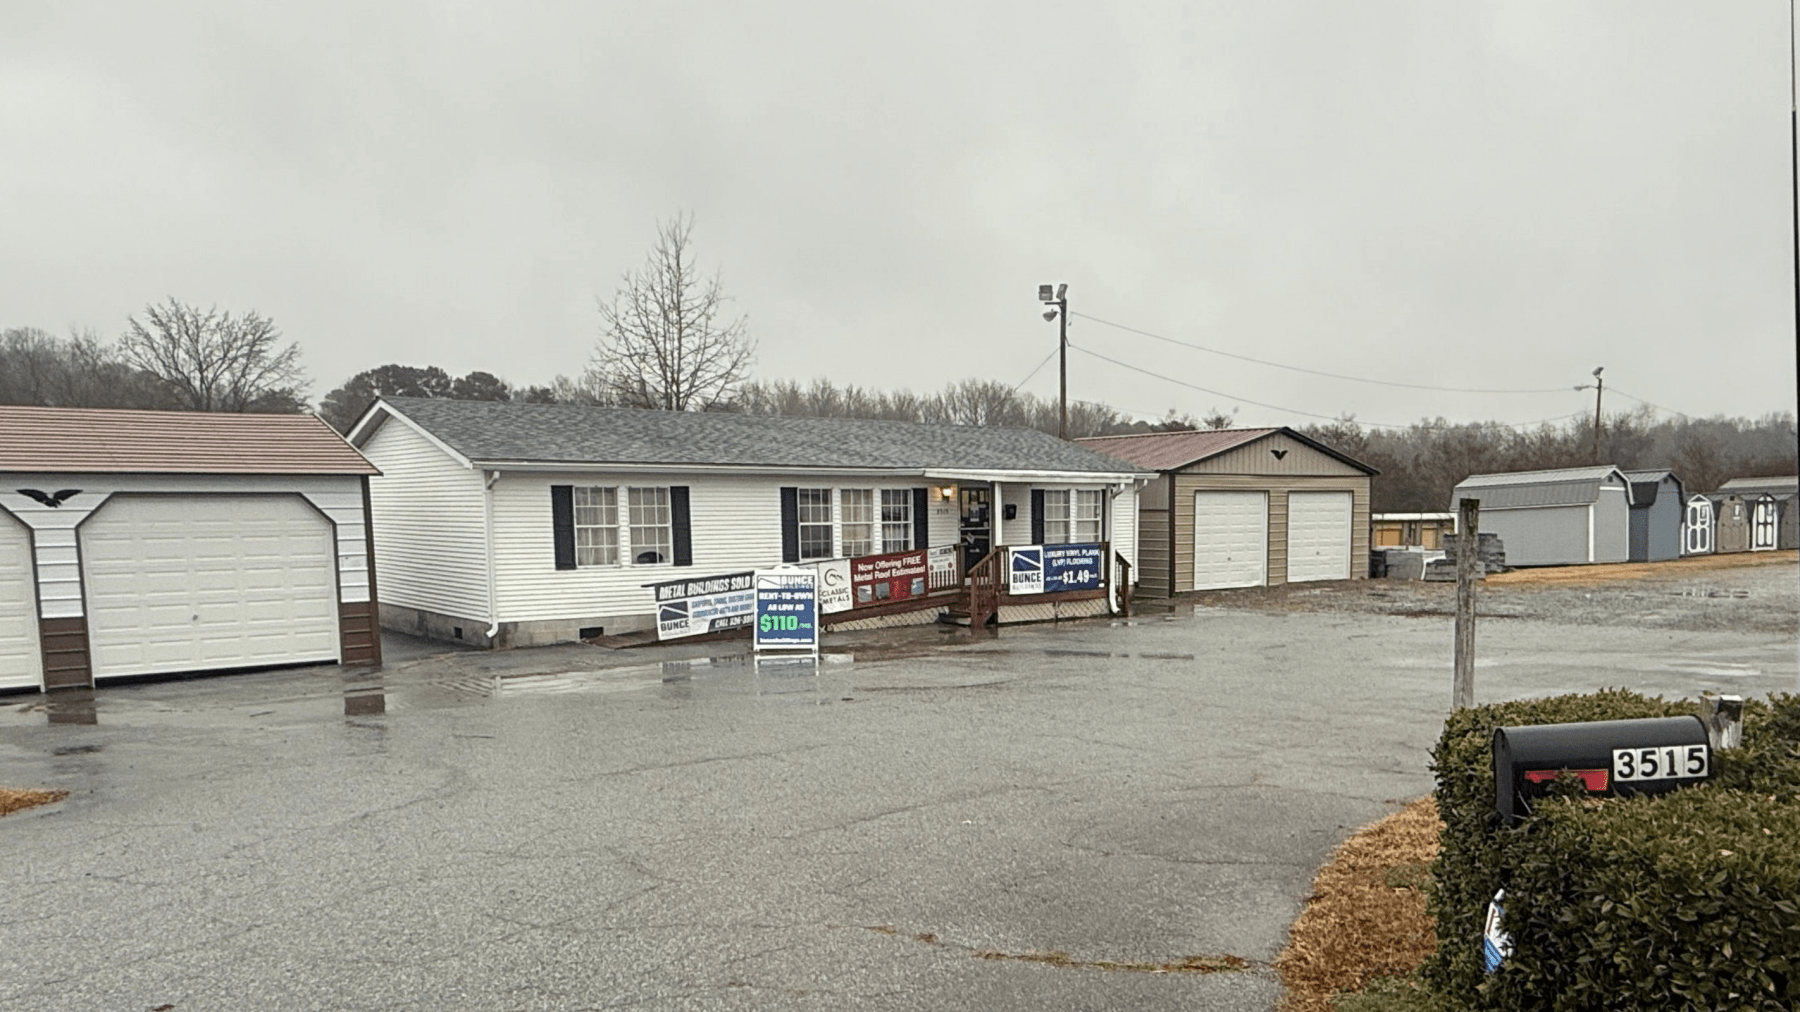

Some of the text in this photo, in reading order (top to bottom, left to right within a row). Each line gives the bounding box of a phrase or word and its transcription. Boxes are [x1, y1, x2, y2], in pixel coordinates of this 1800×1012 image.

[1066, 549, 1081, 557] VINYL
[858, 563, 874, 572] Now
[875, 560, 902, 569] Offering
[902, 555, 922, 566] FREE
[1066, 557, 1093, 566] FLOORING
[781, 575, 814, 585] BUNCE
[854, 572, 873, 583] Metal
[874, 569, 891, 579] Roof
[1012, 572, 1042, 584] BUNCE
[1062, 569, 1090, 585] $1.49
[659, 583, 686, 600] METAL
[687, 578, 730, 596] BUILDINGS
[731, 575, 751, 590] SOLD
[820, 587, 850, 597] CLASSIC
[759, 592, 814, 600] RENT-TO-OWN
[822, 594, 850, 604] METALS
[767, 603, 805, 611] AS LOW AS
[660, 619, 690, 632] BUNCE
[715, 618, 729, 628] CALL
[759, 613, 798, 633] $110
[1617, 747, 1705, 779] 3515
